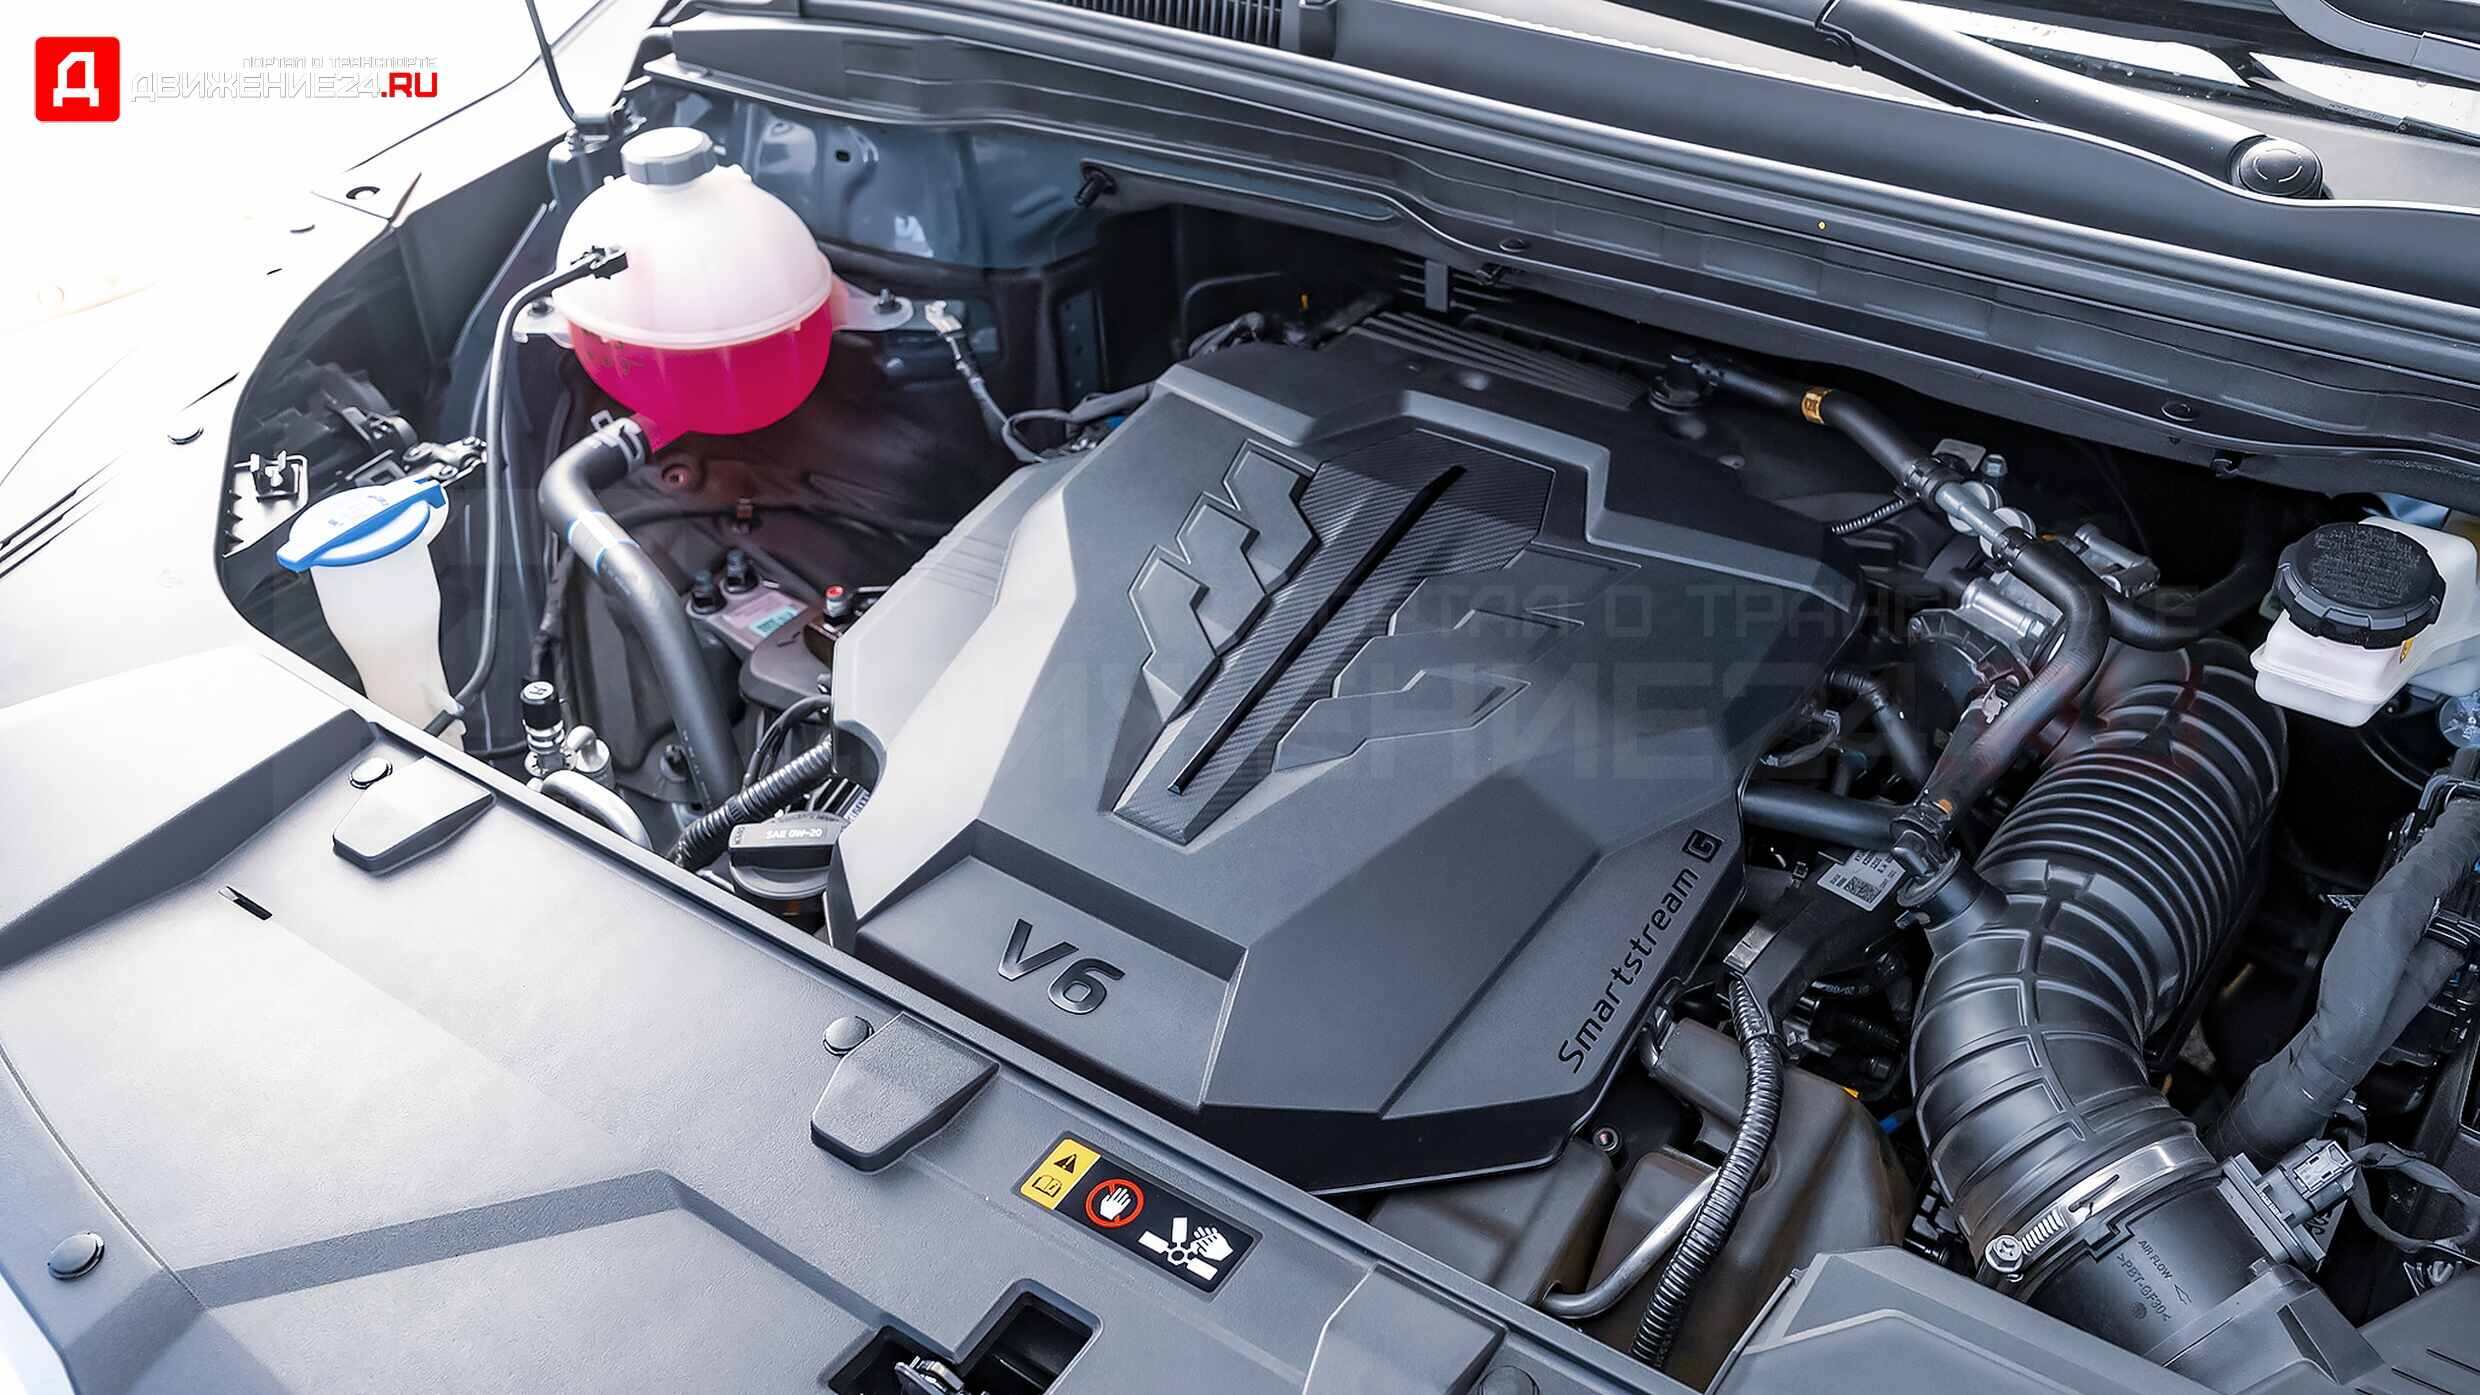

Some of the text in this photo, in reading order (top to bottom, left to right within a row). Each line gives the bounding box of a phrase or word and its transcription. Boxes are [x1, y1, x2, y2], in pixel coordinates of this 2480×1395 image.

[998, 918, 1126, 1015] V6
[1557, 867, 1699, 1074] Smartstream
[2138, 1240, 2173, 1279] AIR FLOW
